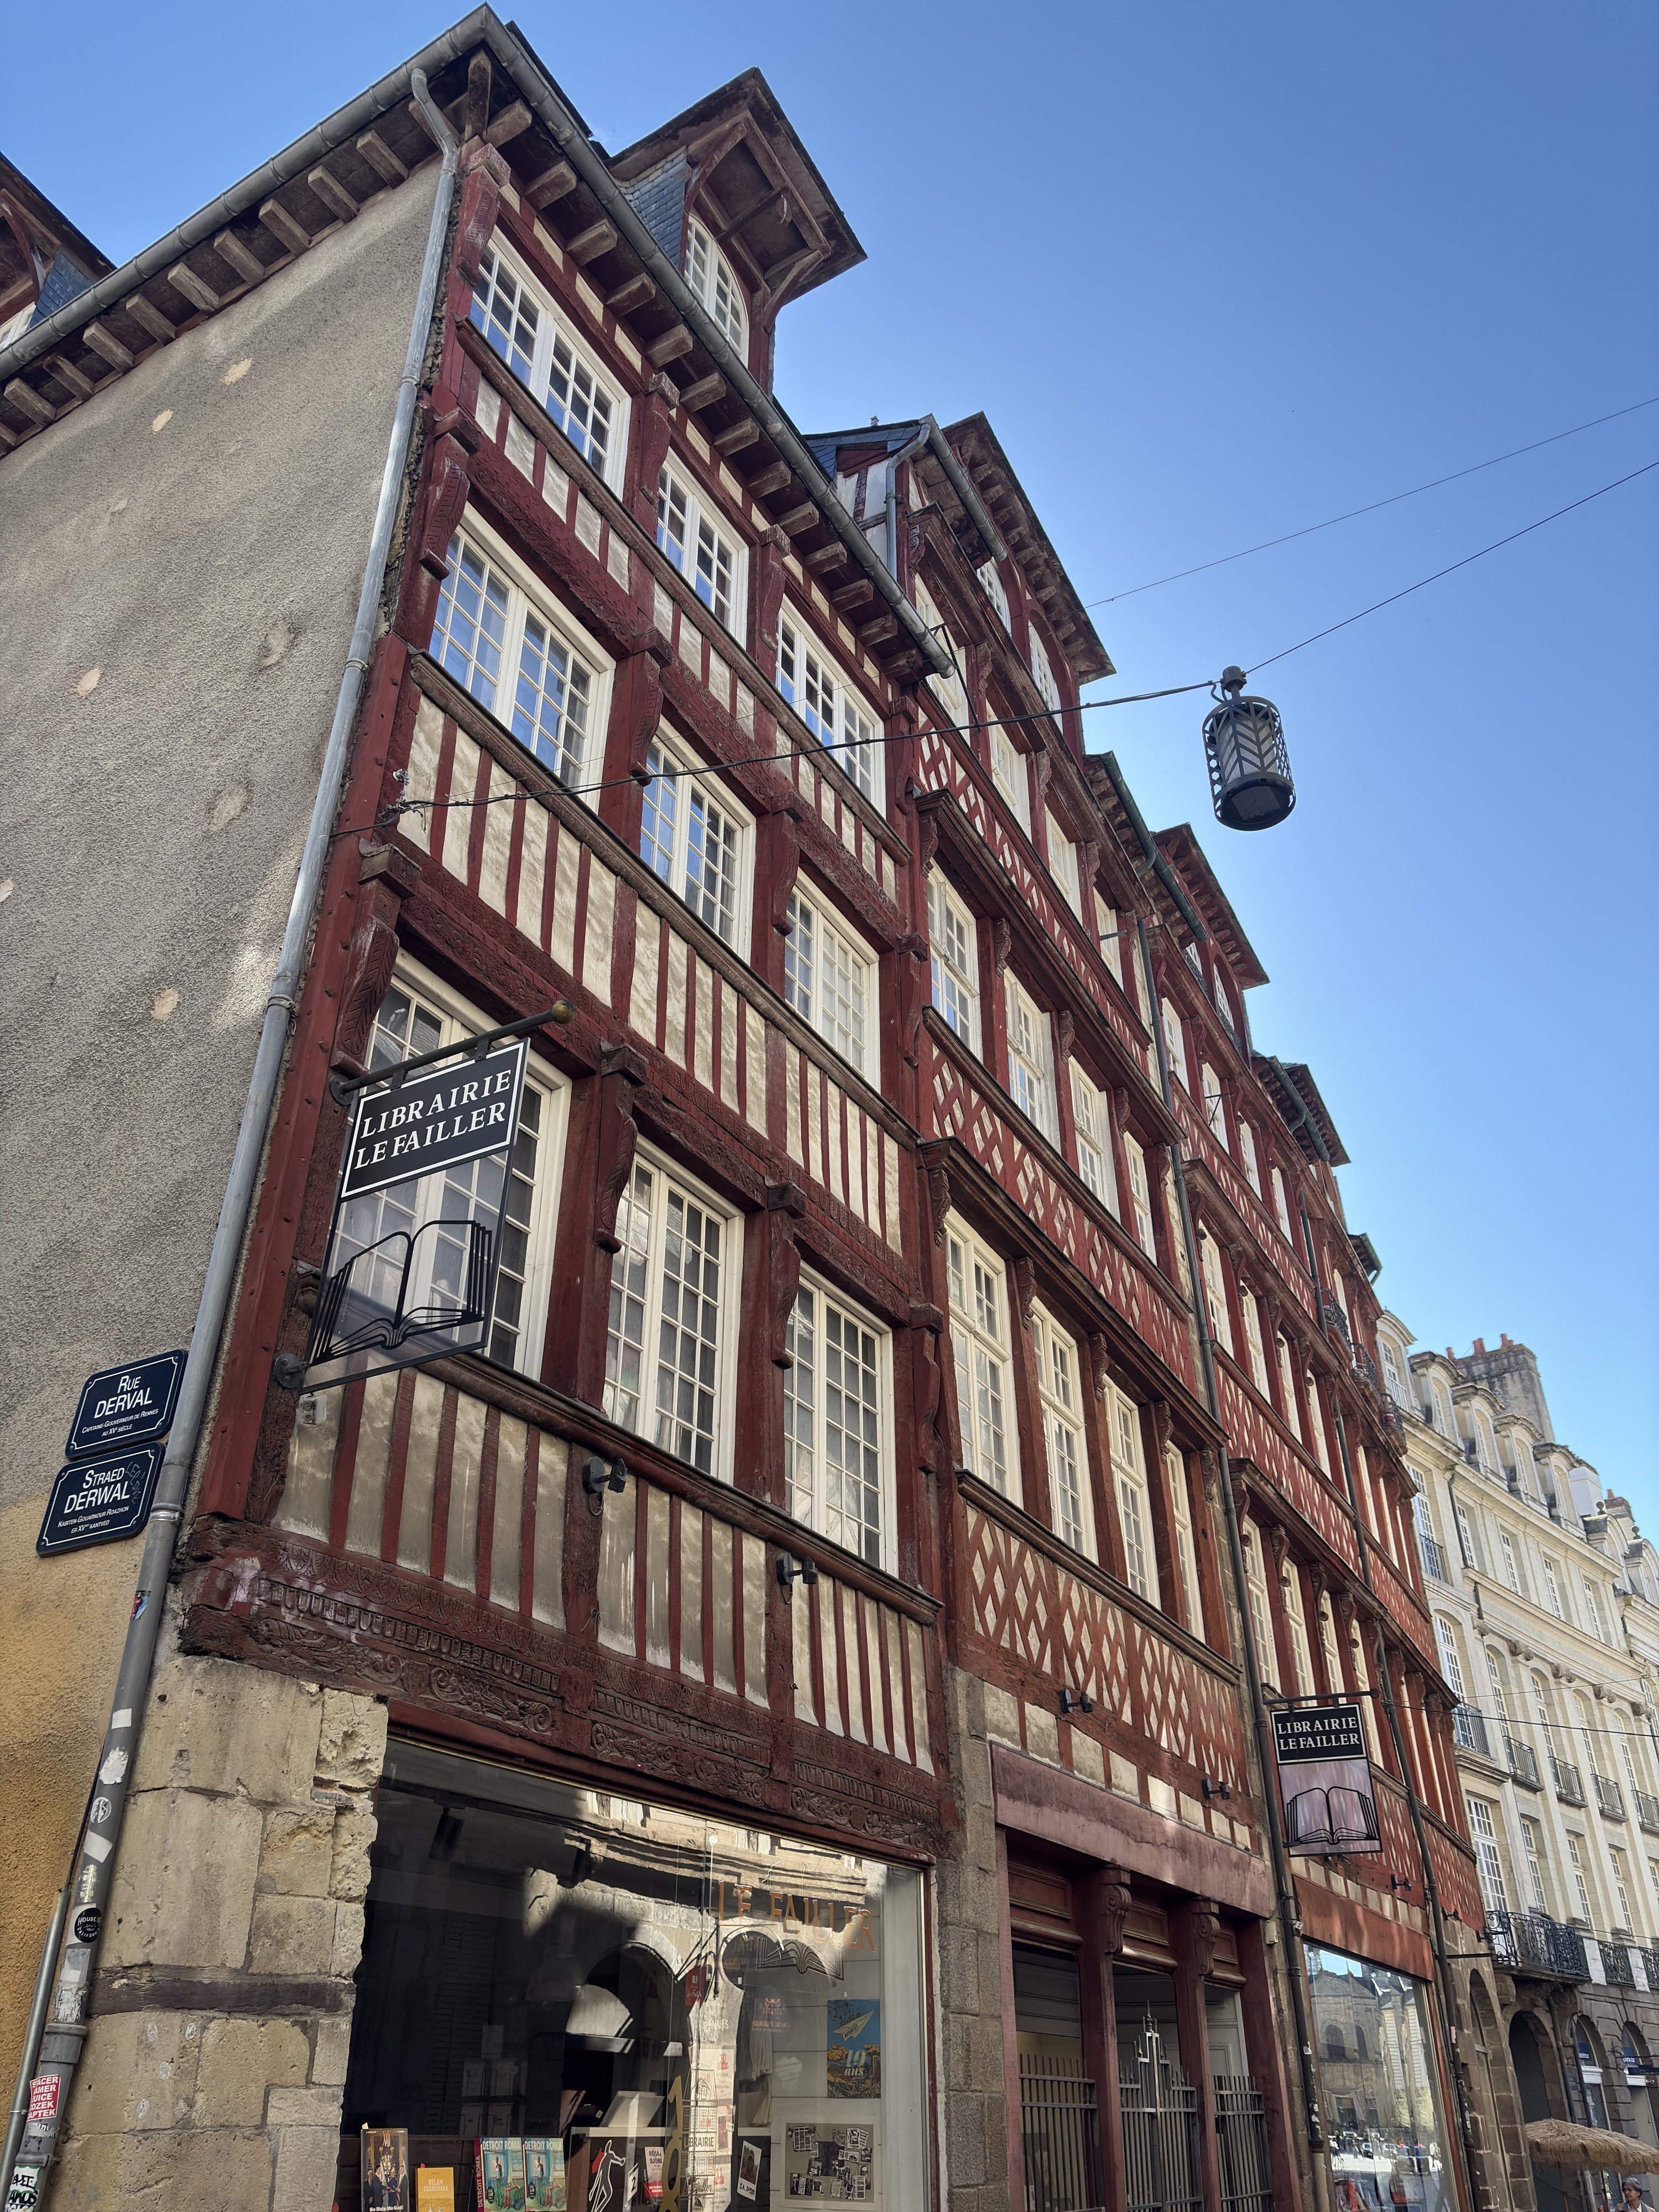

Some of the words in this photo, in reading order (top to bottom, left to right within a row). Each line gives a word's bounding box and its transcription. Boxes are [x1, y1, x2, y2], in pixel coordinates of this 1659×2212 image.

[360, 1070, 512, 1139] LIBRAIRIE
[354, 1140, 388, 1170] LE
[390, 1102, 505, 1157] FAILLER
[117, 1375, 141, 1394] RUE
[93, 1387, 152, 1418] DERVAL
[140, 1408, 159, 1418] RENNES
[83, 1468, 124, 1489] STRAED
[64, 1481, 130, 1514] DERWAL
[106, 1506, 129, 1516] ROAZHON
[1277, 1717, 1358, 1734] LIBRAIRIE
[1279, 1738, 1297, 1750] LE
[1298, 1733, 1360, 1749] FAILLER
[77, 1917, 96, 1927] HOUSE
[719, 1881, 753, 1927] LE
[770, 1892, 876, 1952] FAILLER
[482, 2141, 503, 2150] DETROIT
[504, 2141, 520, 2150] ROMA
[525, 2141, 545, 2150] DETROIT
[546, 2141, 563, 2150] ROMA
